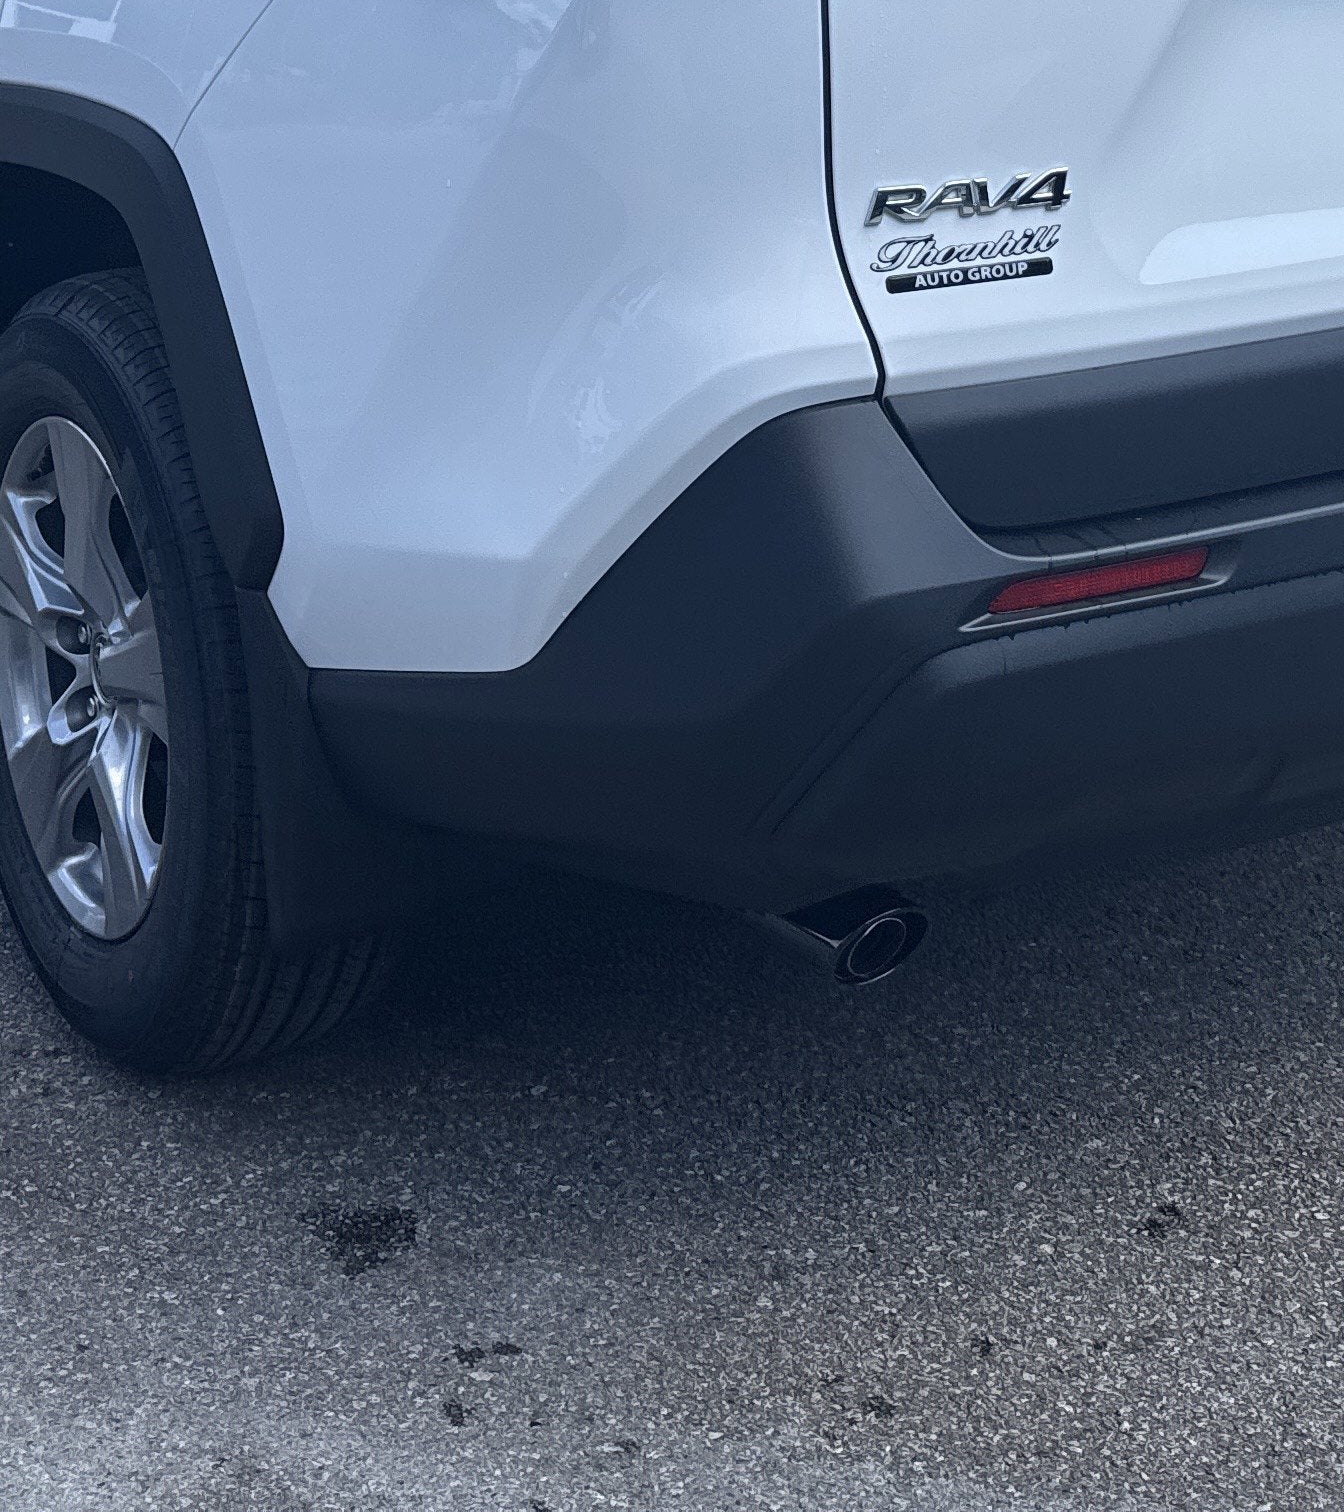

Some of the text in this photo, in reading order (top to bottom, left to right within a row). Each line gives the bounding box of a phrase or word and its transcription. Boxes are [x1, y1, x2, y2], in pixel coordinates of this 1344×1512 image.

[864, 166, 1073, 226] RAV4
[869, 223, 1062, 273] Thornhill
[914, 261, 1029, 288] AUTO GROUP
